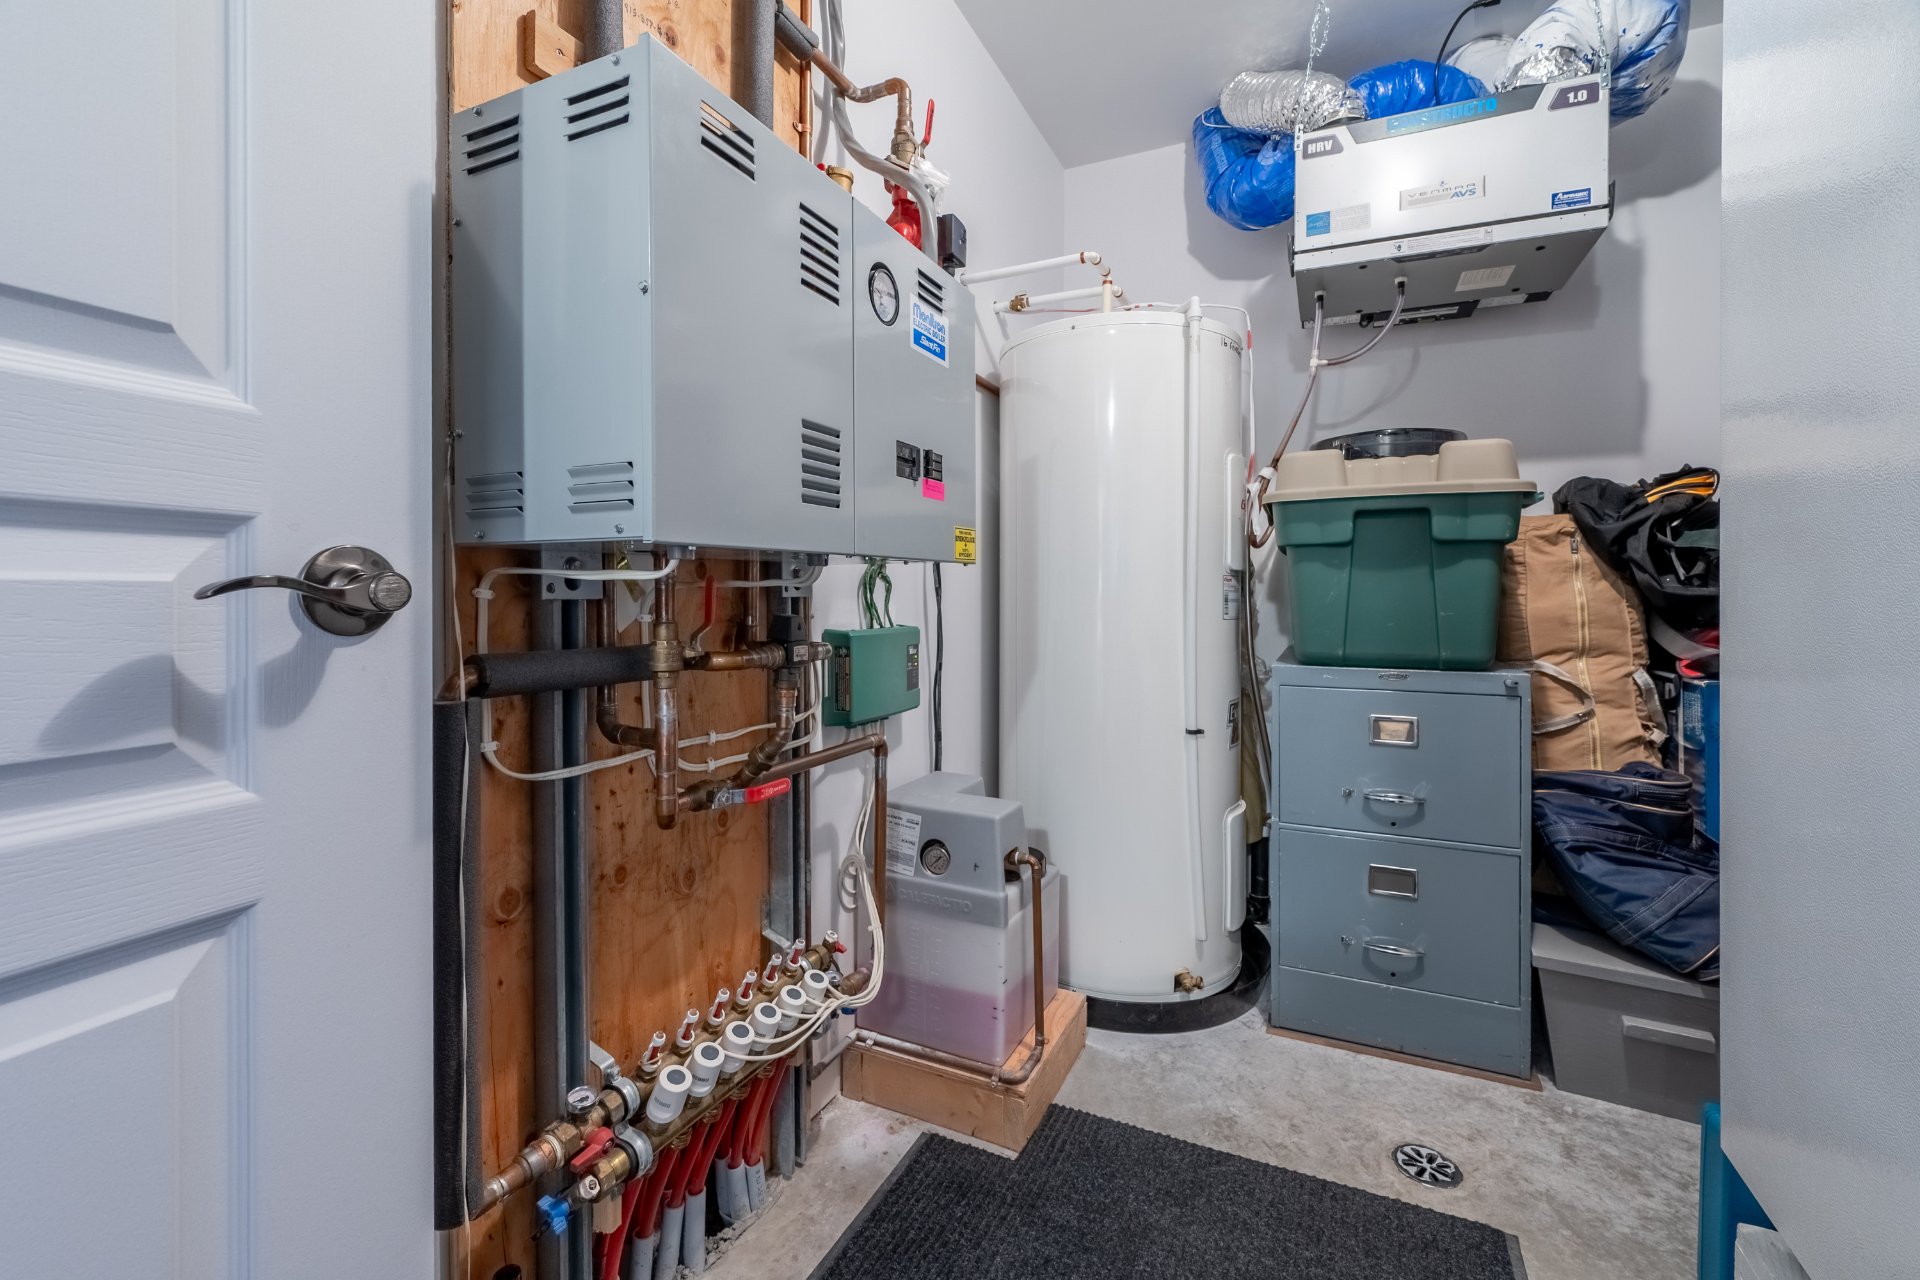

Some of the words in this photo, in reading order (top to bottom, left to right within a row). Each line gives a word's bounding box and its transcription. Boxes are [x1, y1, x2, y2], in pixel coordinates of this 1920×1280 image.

[1567, 90, 1588, 104] 1.0
[1307, 140, 1333, 154] HRV
[1450, 188, 1477, 199] AVS
